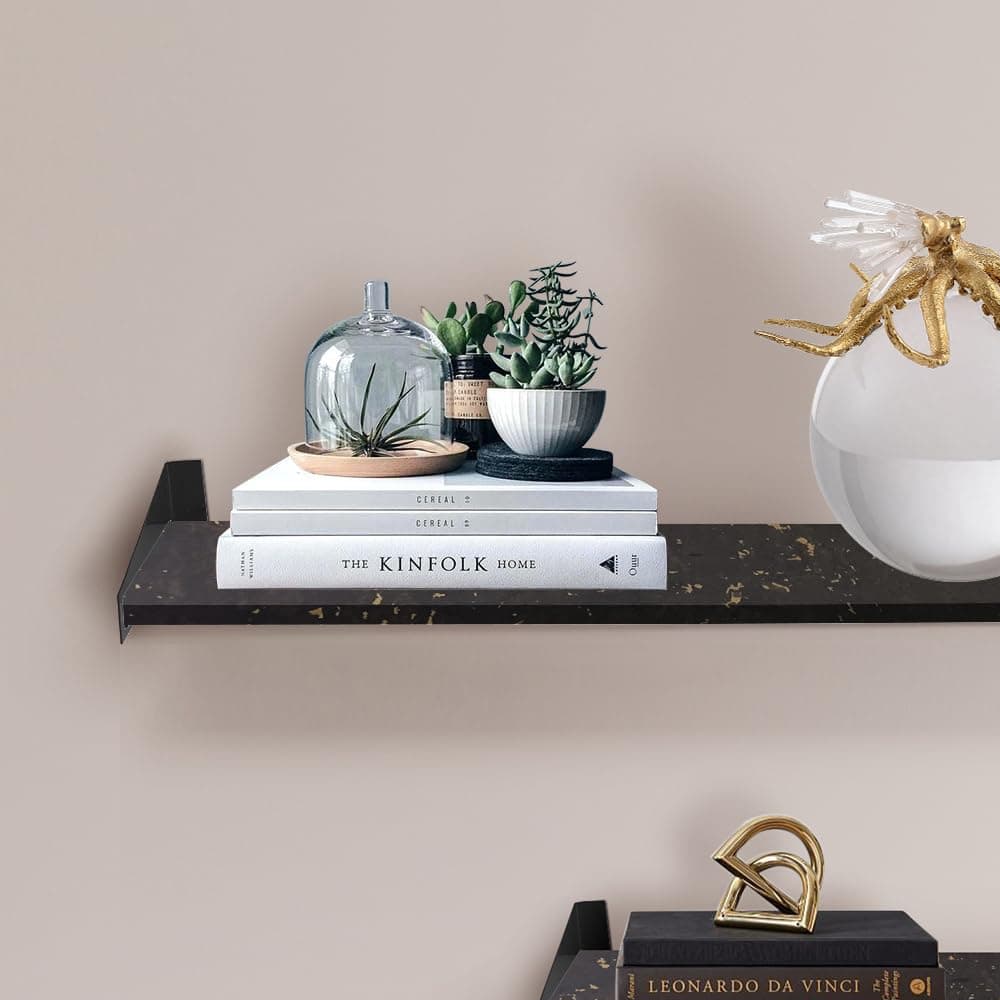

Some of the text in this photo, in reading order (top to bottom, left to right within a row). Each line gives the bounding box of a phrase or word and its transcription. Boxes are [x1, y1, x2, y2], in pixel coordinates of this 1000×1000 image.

[416, 495, 455, 504] CEREAL
[416, 519, 455, 528] CEREAL
[341, 556, 537, 572] THE KINFOLK HOME
[648, 979, 861, 993] LEONARDO DA VINCI
[872, 979, 881, 993] The
